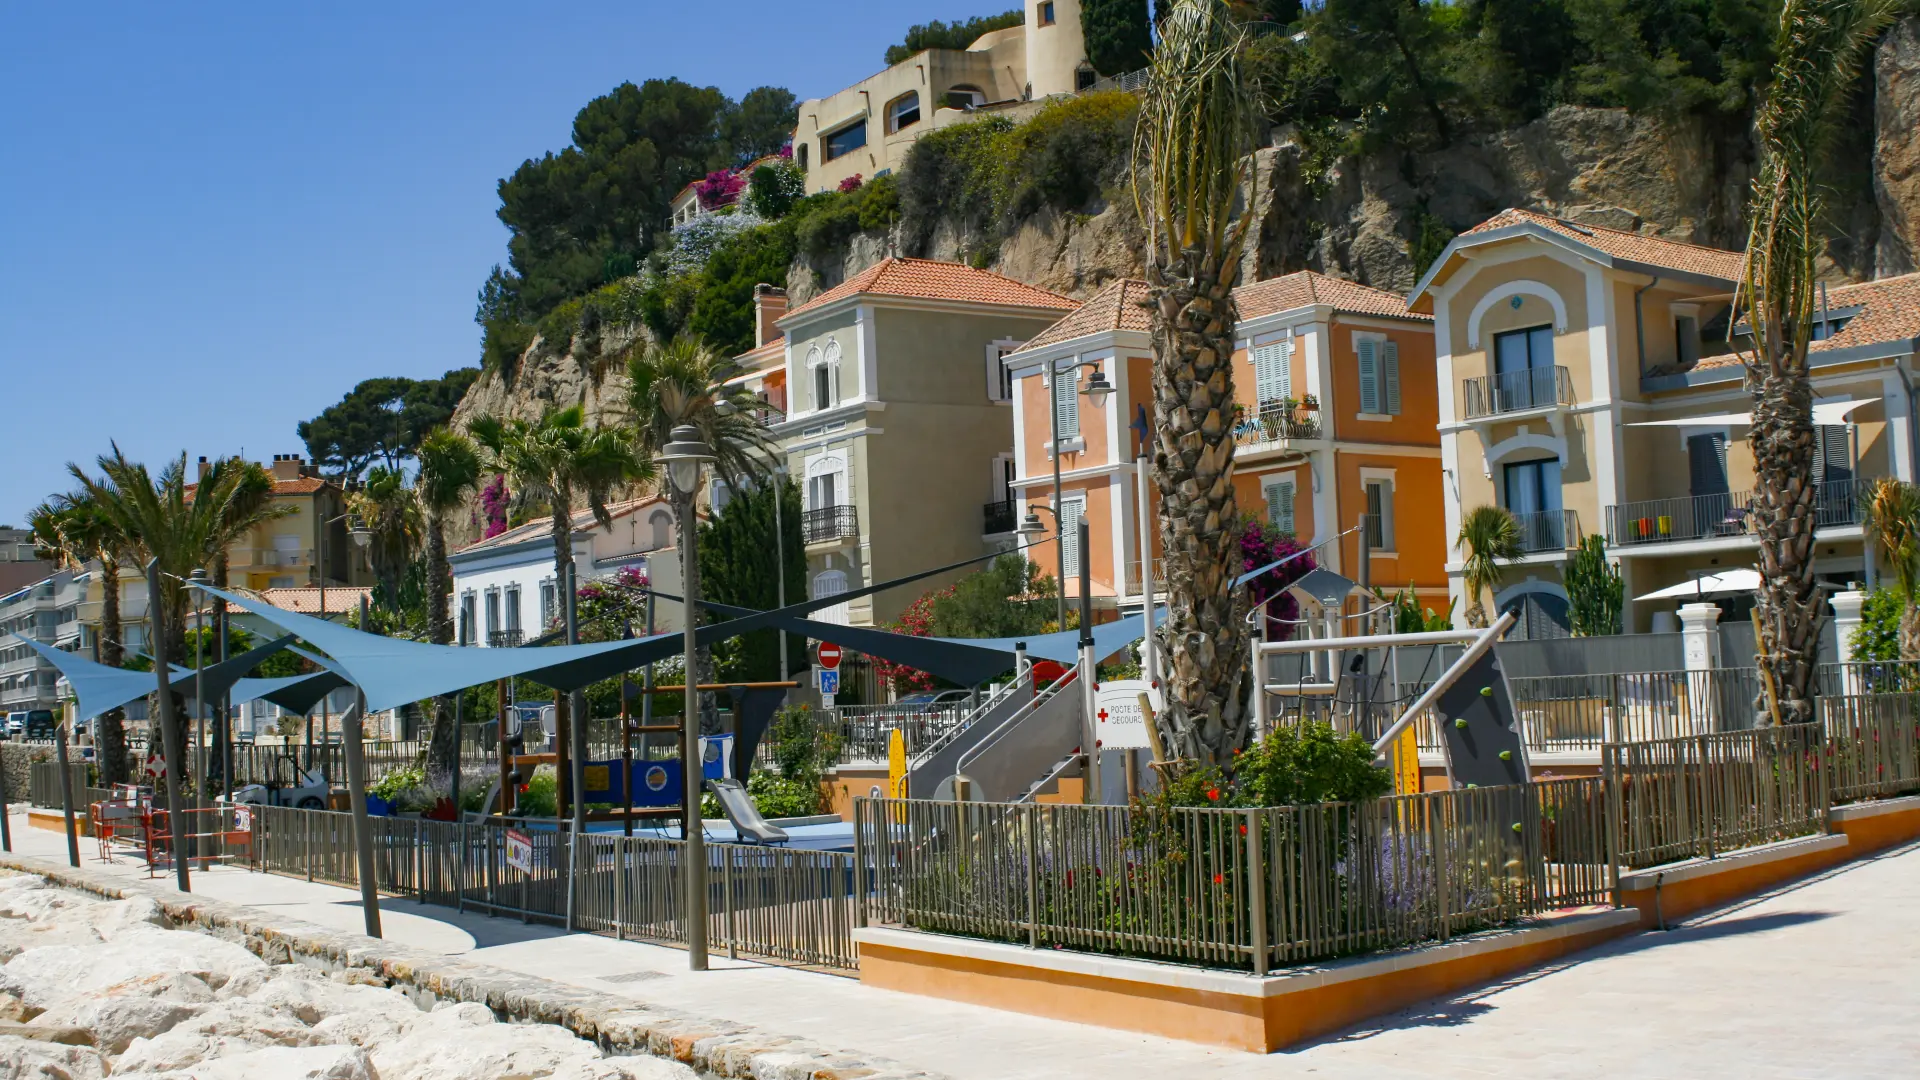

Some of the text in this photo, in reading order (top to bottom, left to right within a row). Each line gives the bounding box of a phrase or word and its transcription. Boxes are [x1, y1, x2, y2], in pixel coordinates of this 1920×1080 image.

[1110, 704, 1142, 713] POSTE DE
[1112, 716, 1142, 724] SECOURS
